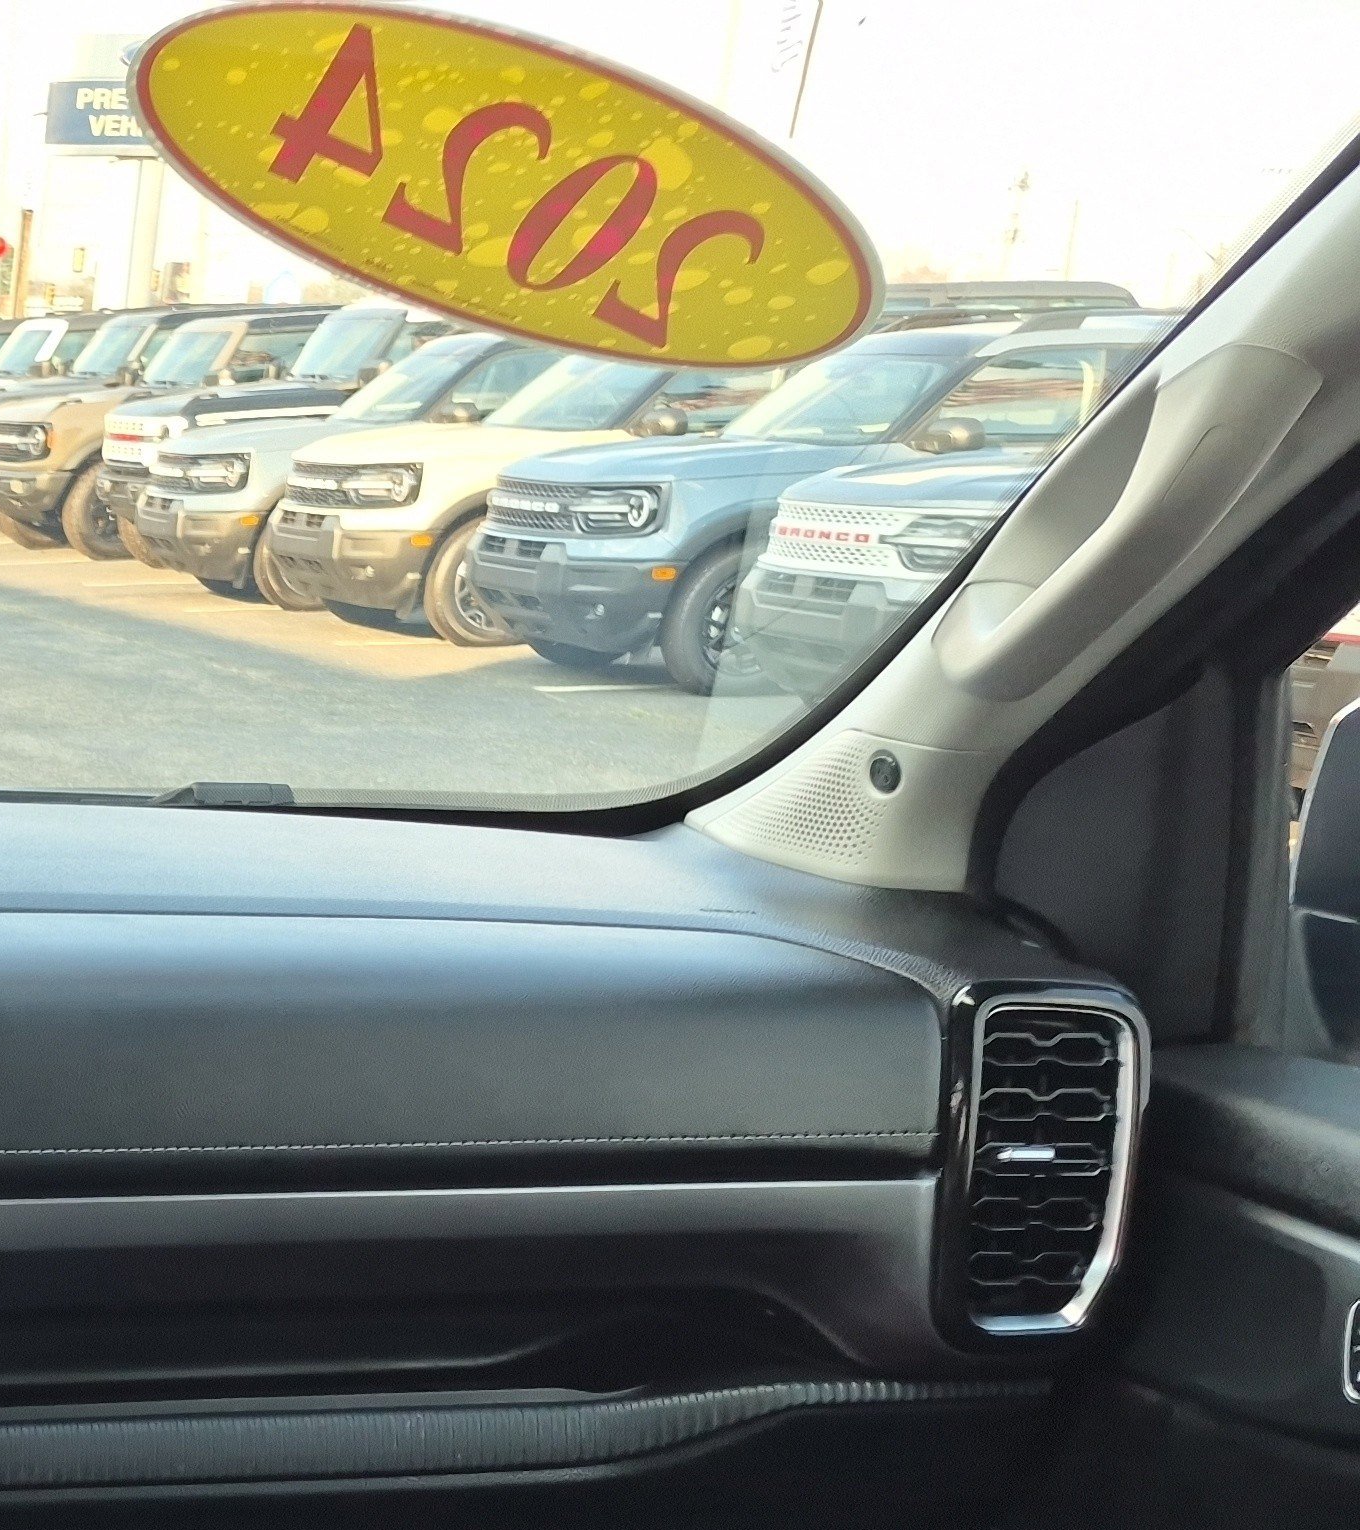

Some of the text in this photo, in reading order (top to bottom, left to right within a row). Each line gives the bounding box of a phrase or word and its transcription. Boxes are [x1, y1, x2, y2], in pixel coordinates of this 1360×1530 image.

[76, 88, 130, 110] PRE
[89, 115, 142, 137] VEH
[778, 526, 870, 543] BRONCO
